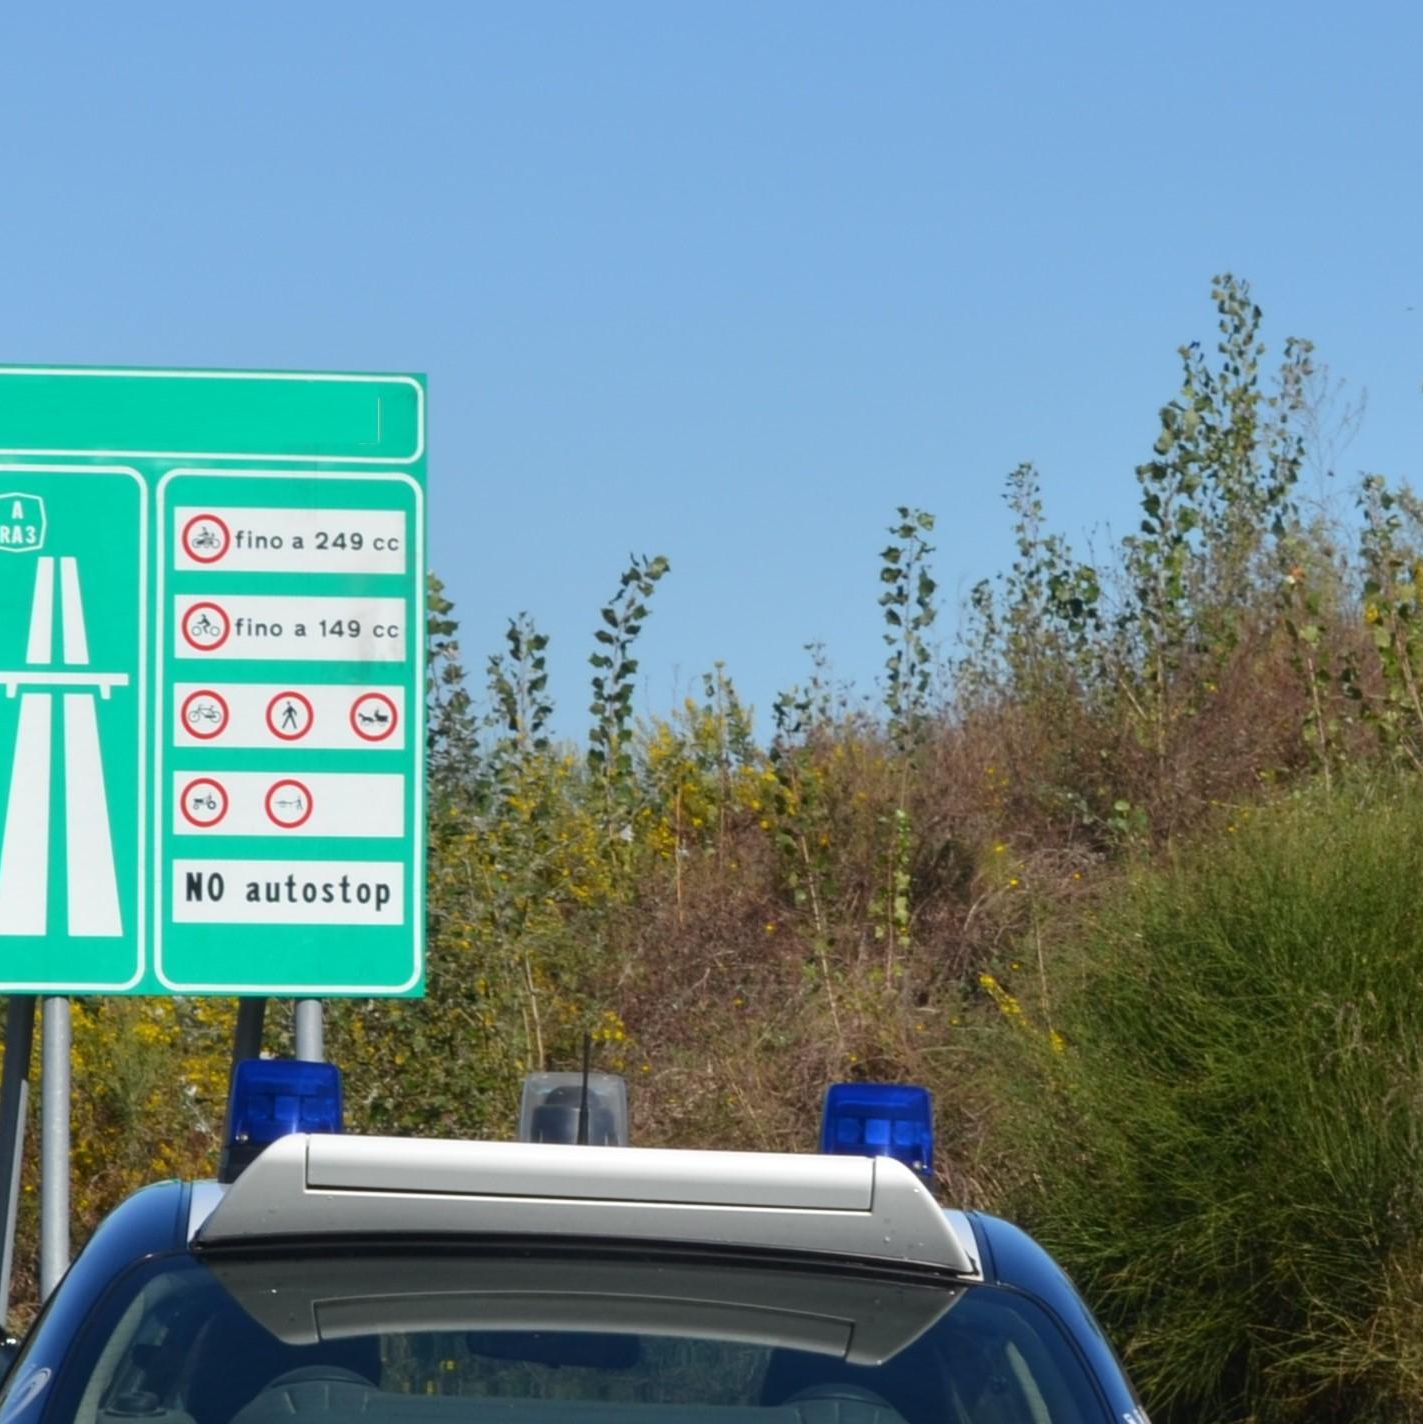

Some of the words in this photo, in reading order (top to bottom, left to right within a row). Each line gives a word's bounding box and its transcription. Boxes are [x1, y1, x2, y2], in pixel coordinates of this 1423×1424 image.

[11, 500, 25, 519] A
[0, 525, 37, 544] RA3
[235, 530, 284, 550] fino
[291, 535, 305, 550] a
[314, 531, 364, 551] 249
[372, 536, 400, 552] cc
[235, 618, 283, 637] fino
[294, 623, 307, 638] a
[318, 619, 362, 639] 149
[372, 624, 400, 639] cc
[185, 871, 225, 902] NO
[245, 873, 391, 912] autostop
